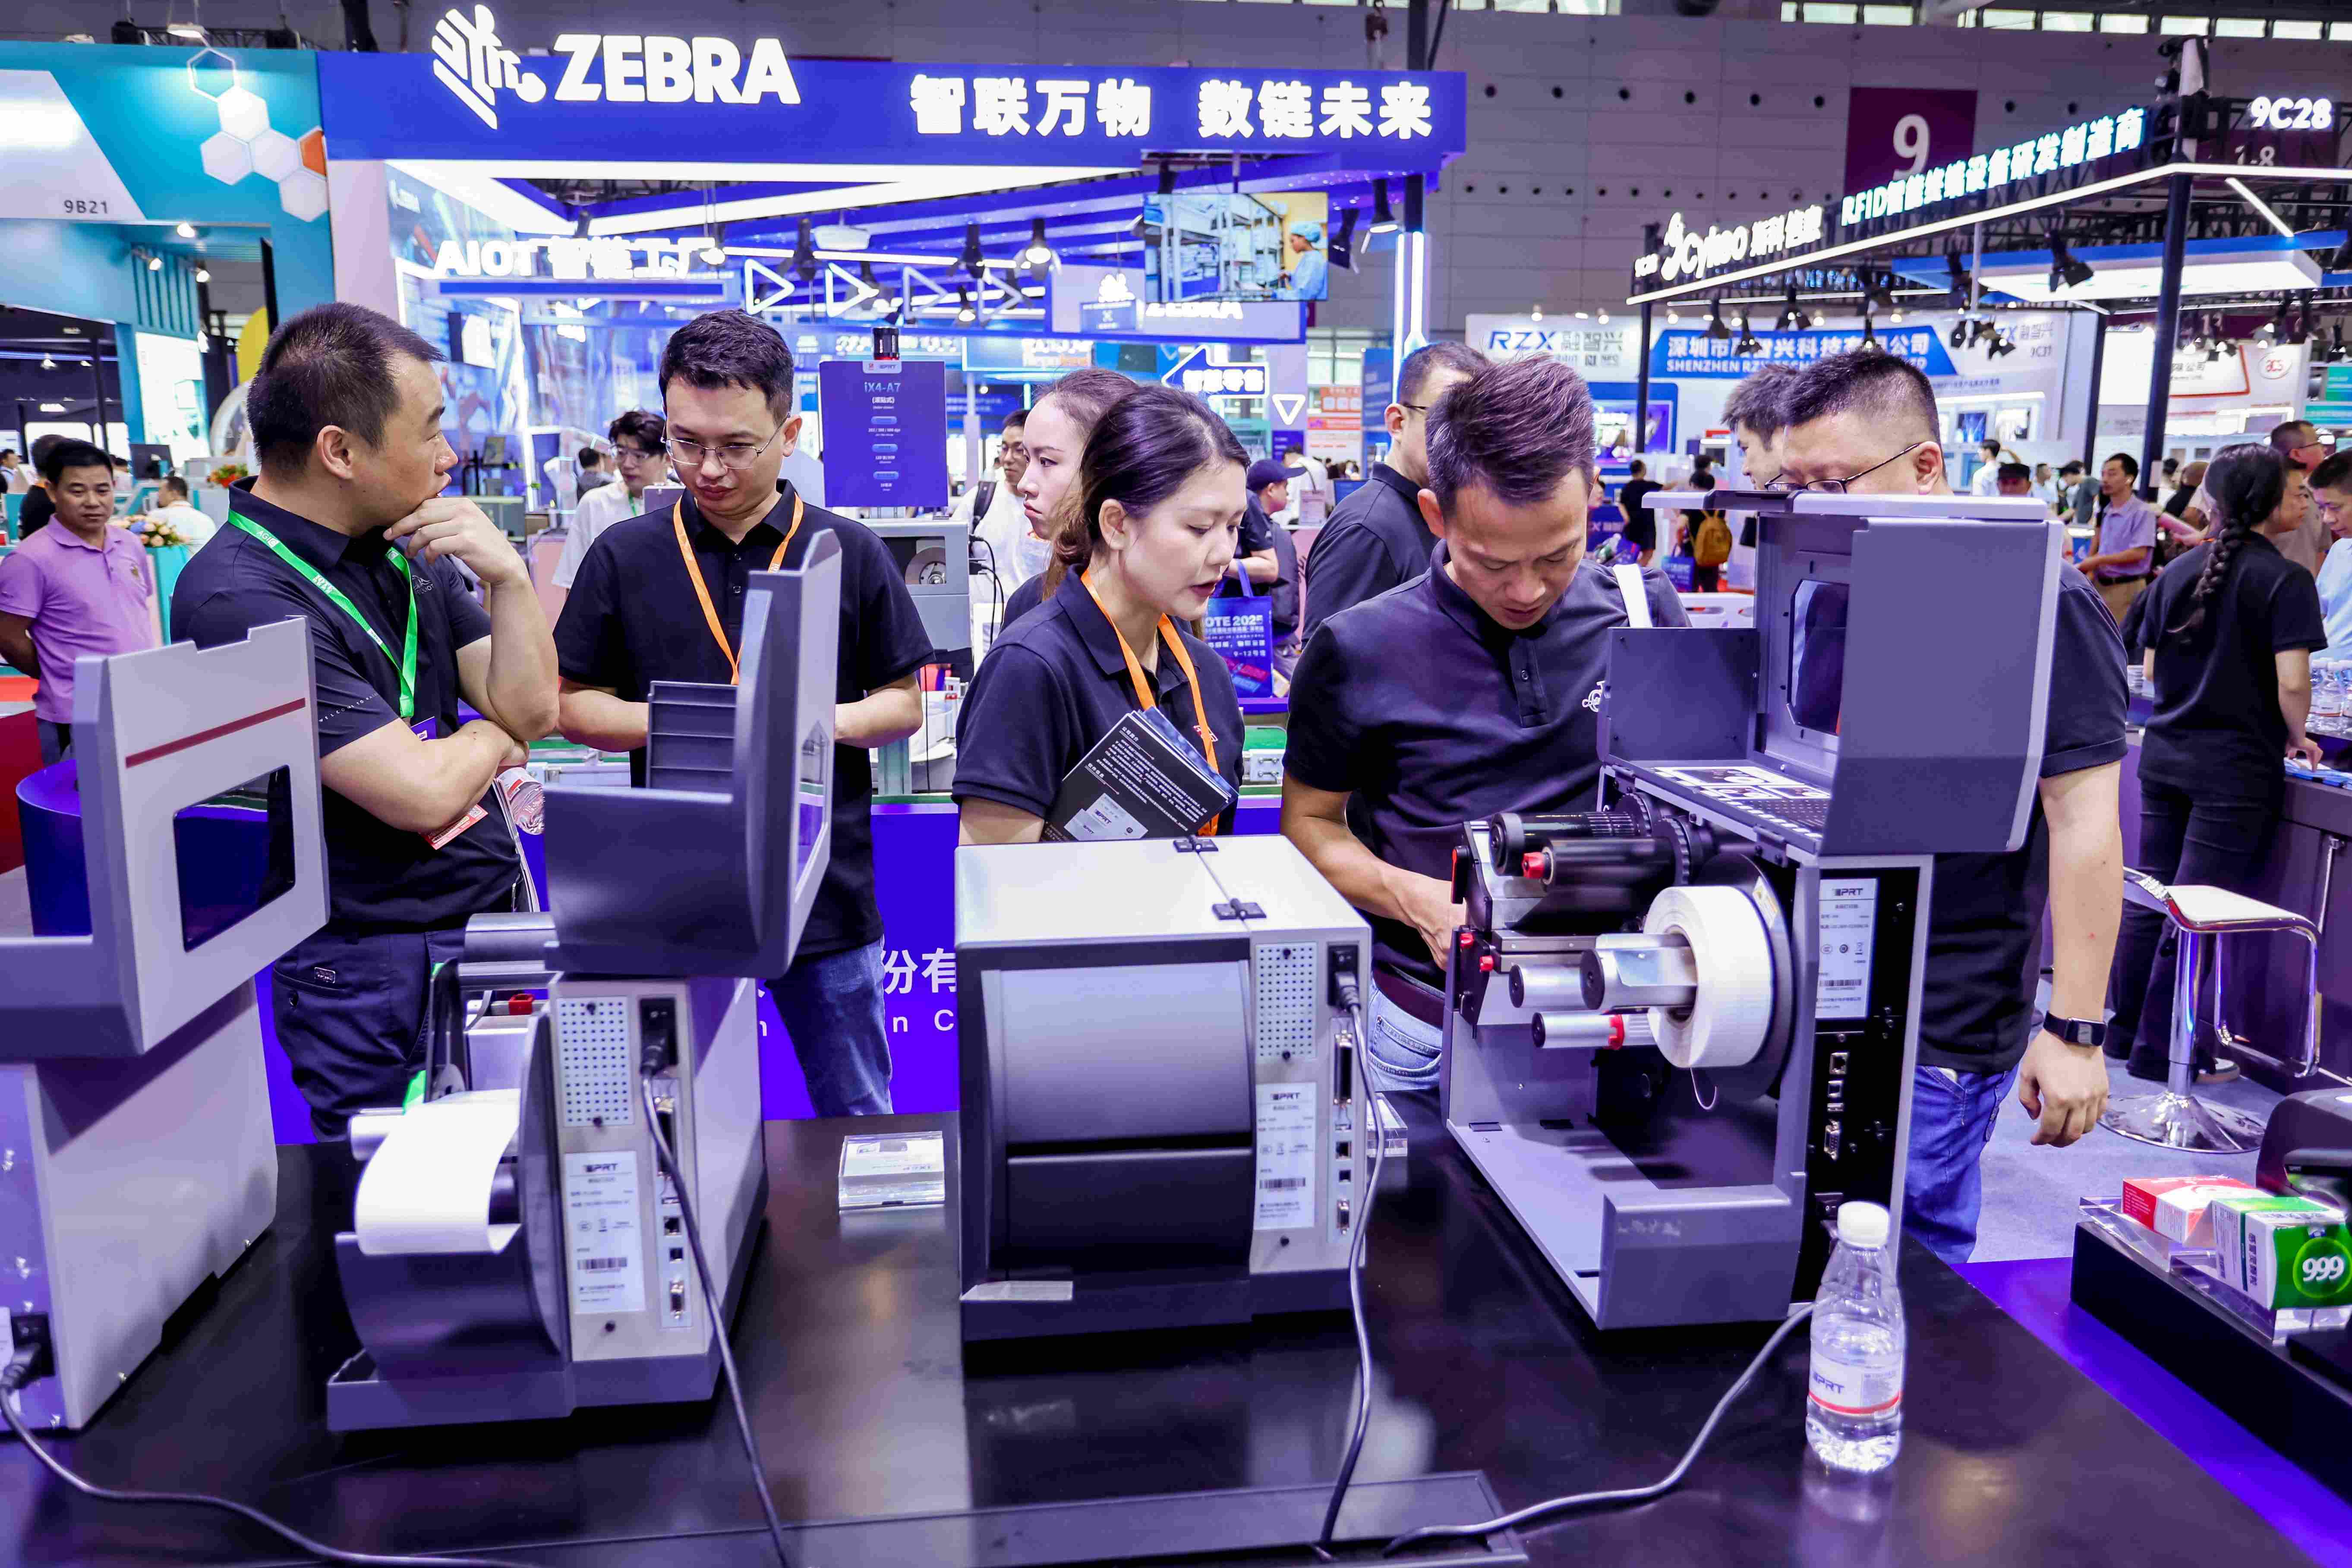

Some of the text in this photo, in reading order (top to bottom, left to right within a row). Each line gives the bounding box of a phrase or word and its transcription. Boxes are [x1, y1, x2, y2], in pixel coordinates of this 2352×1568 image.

[553, 34, 801, 104] ZEBRA
[909, 74, 1433, 139] 智联万物 数链未来
[2251, 96, 2332, 129] 9C28
[1893, 114, 1930, 180] 9
[63, 200, 108, 215] 9B21
[1489, 331, 1557, 350] RZX
[1666, 359, 1740, 372] SHENZHEN
[864, 382, 901, 393] iX4-A7
[1205, 616, 1231, 627] OTE
[2302, 1256, 2344, 1281] 999
